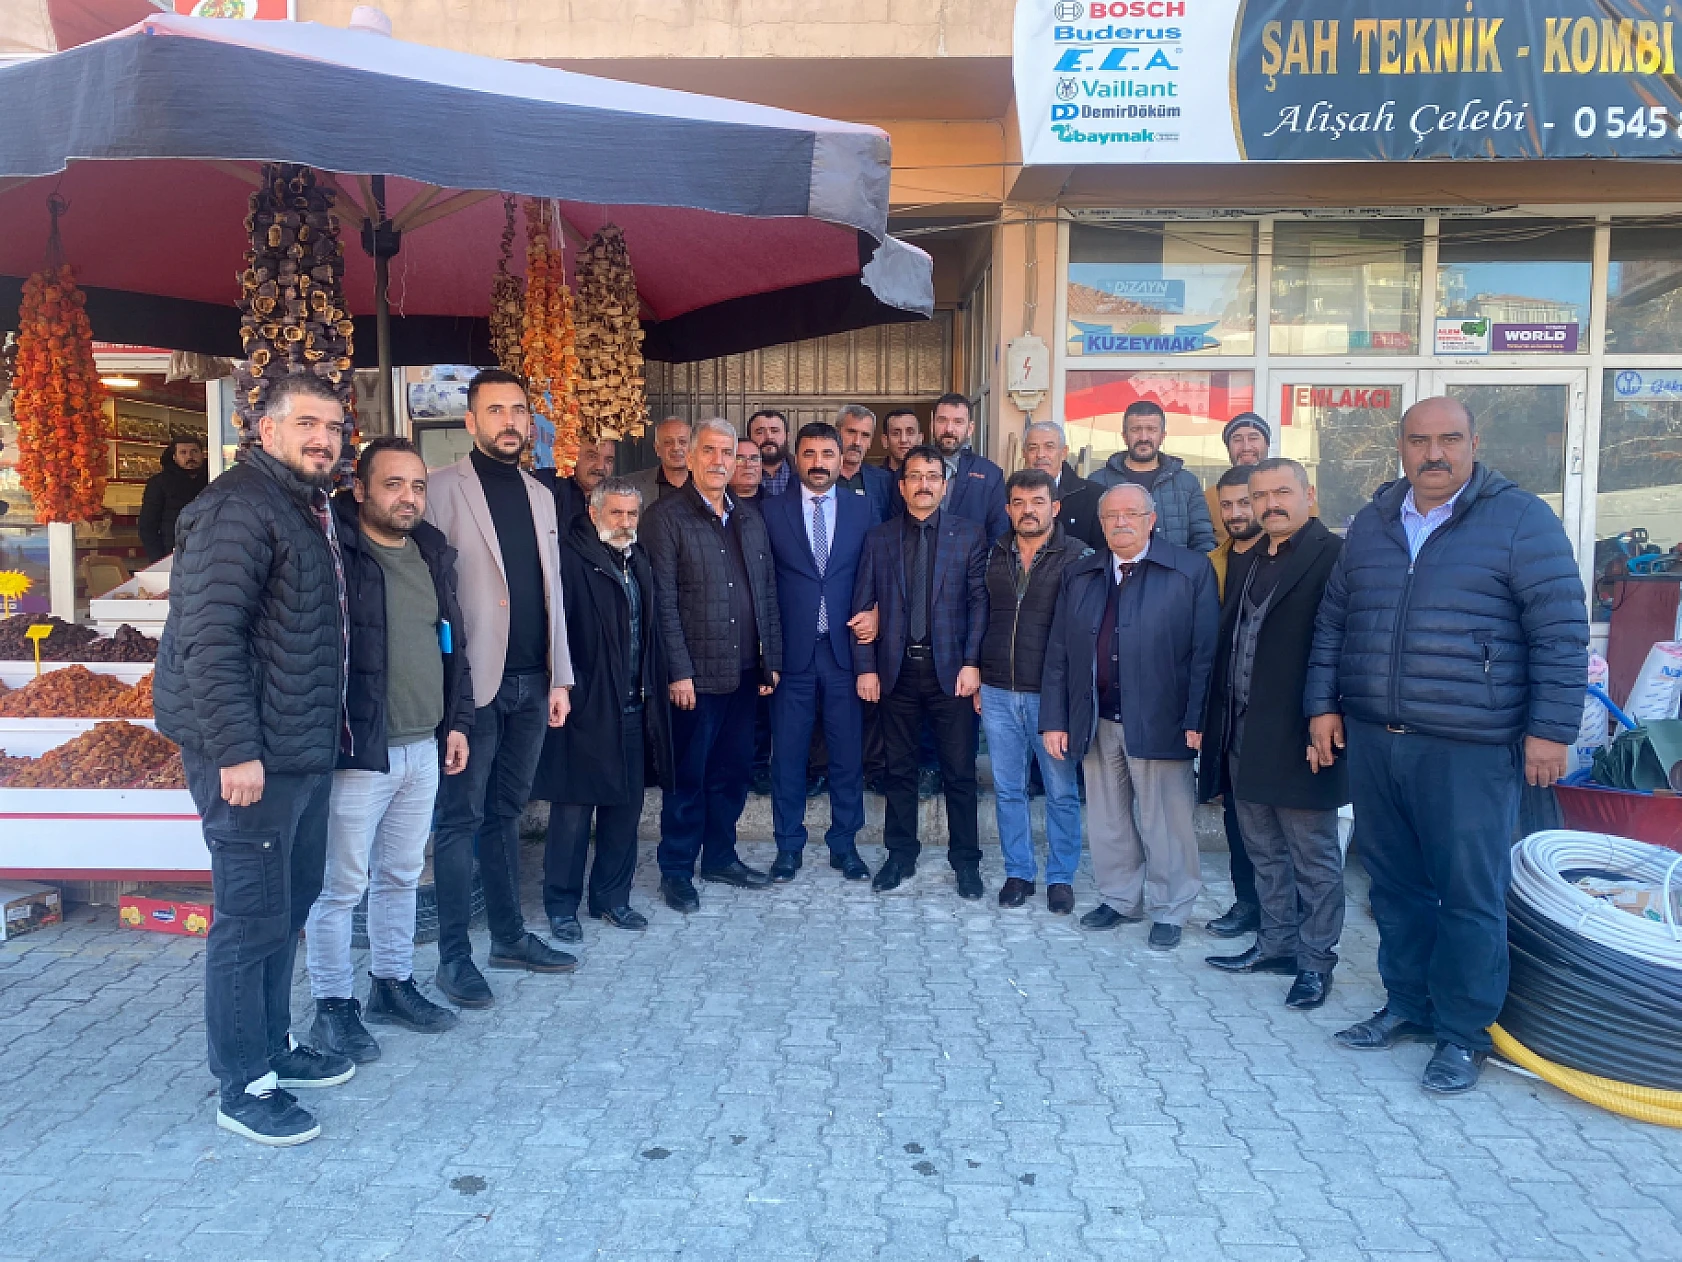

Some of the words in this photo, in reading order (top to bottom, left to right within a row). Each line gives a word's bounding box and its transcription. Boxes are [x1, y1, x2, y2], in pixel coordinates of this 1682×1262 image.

[1090, 1, 1185, 18] BOSCH
[1054, 24, 1182, 41] Buderus
[1261, 19, 1340, 92] ŞAH
[1353, 0, 1505, 75] TEKNİK
[1516, 45, 1530, 58] -
[1542, 5, 1676, 75] KOMBİ
[1081, 79, 1179, 98] Vaillant
[1081, 104, 1182, 119] DemirDöküm
[1262, 100, 1396, 141] Alişah
[1408, 98, 1530, 143] Çelebi
[1605, 106, 1669, 138] 545
[1073, 128, 1155, 145] baymak
[1087, 335, 1199, 351] KUZEYMAK
[1504, 330, 1567, 341] WORLD
